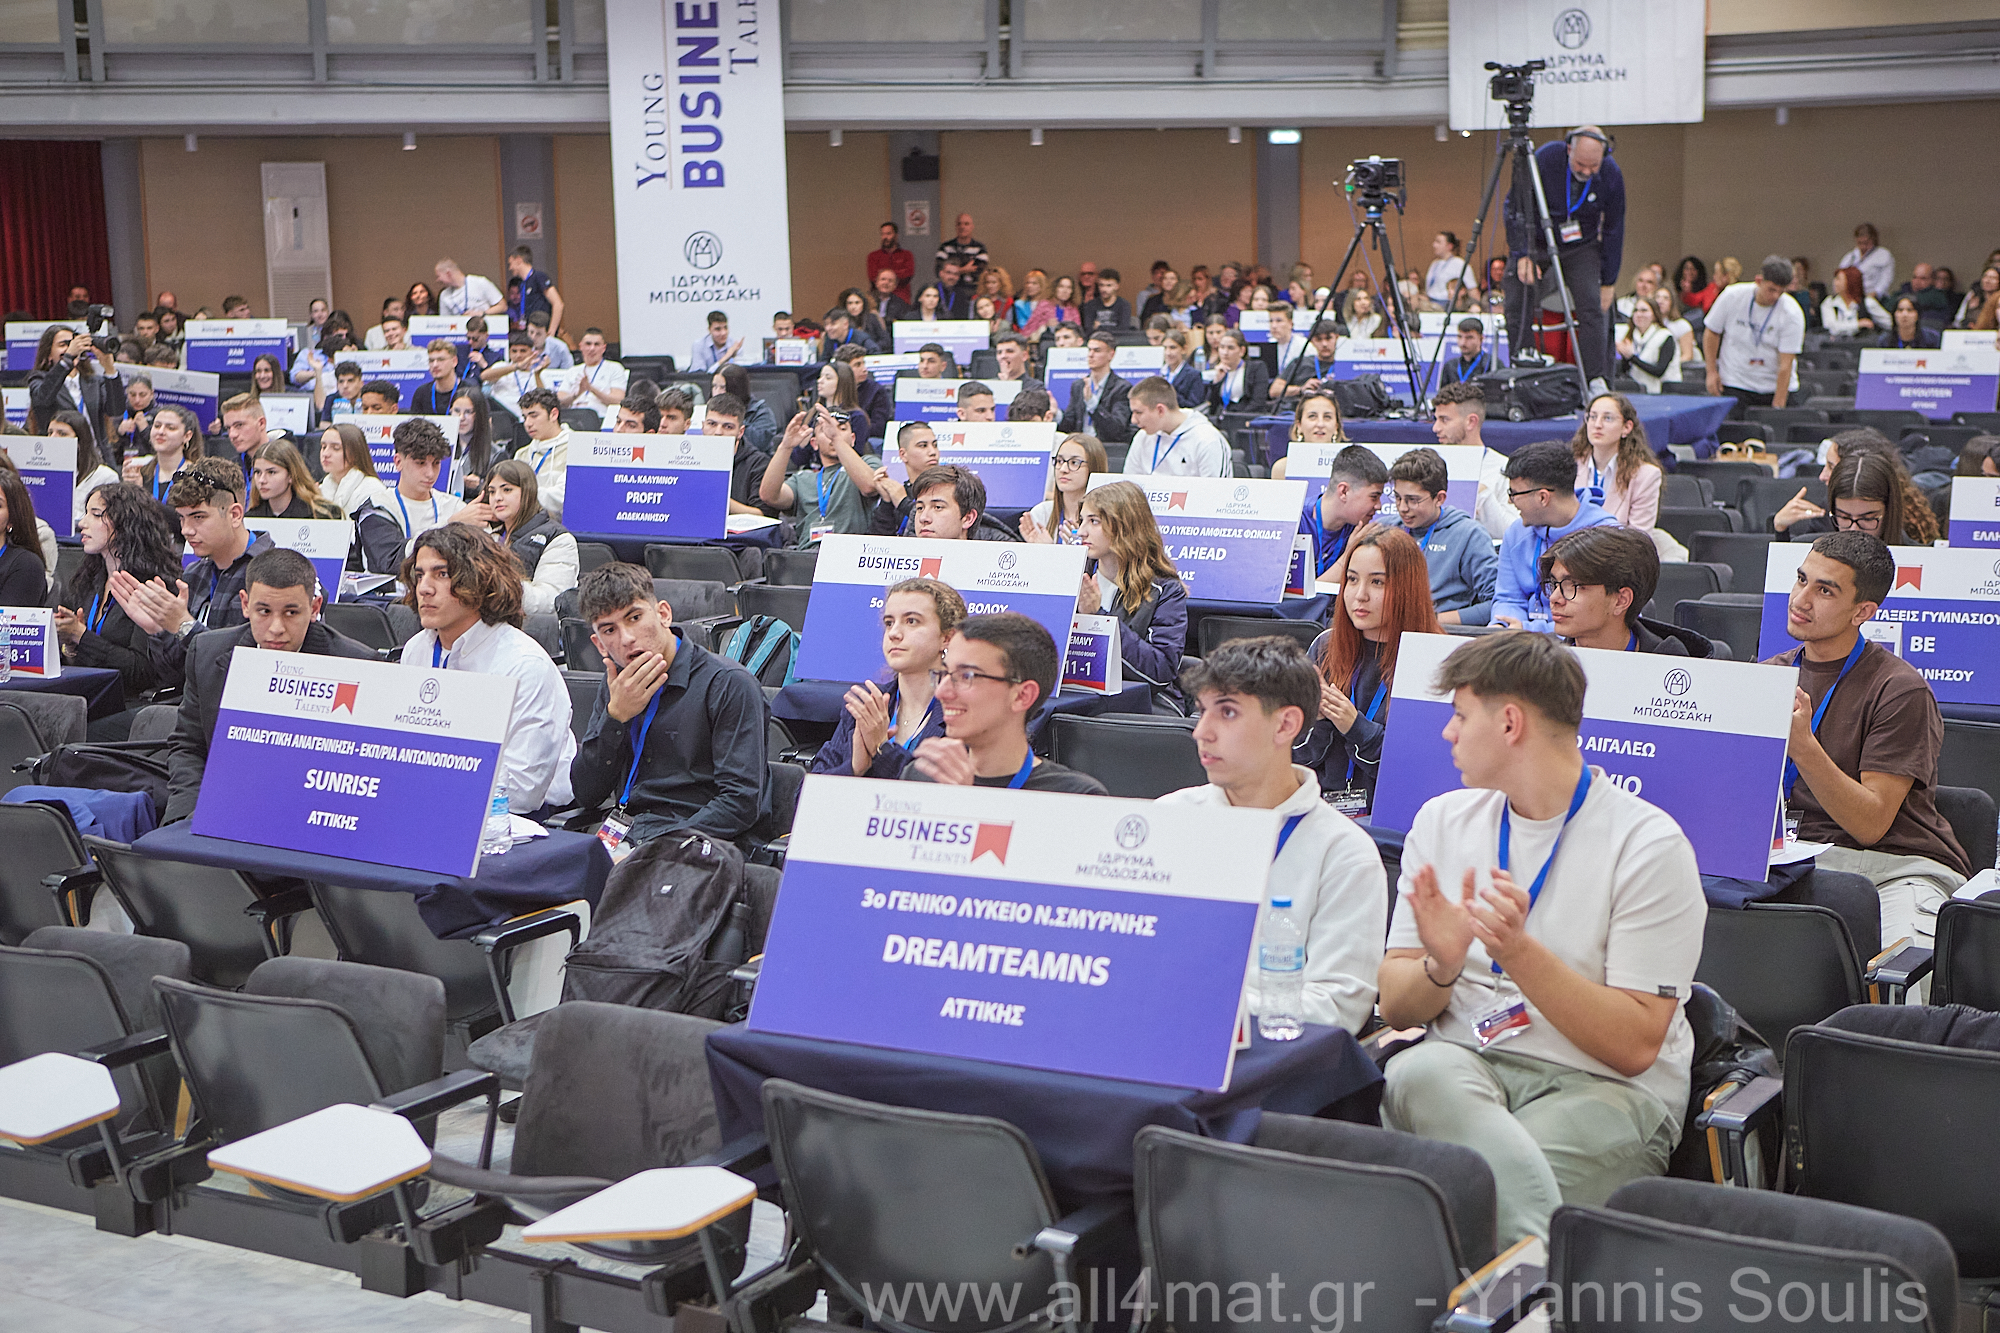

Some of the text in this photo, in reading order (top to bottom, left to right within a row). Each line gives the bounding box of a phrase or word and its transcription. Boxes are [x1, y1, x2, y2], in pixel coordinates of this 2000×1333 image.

[1532, 68, 1627, 84] ΠΟΔΟΣΑΚΗ
[636, 73, 668, 190] YOUNG
[671, 274, 738, 288] ΙΔΡΥΜΑ
[650, 288, 761, 304] ΜΠΟΔΟΣΑΚΗ
[592, 446, 632, 456] BUSINESS
[993, 457, 1041, 465] ΠΑΡΑΣΚΕΥΗΣ
[637, 475, 679, 486] ΚΑΛΥΜΝΟΥ
[626, 491, 664, 504] PROFIT
[616, 511, 670, 522] ΔΩΔΕΚΑΝΗΣΟΥ
[1169, 525, 1200, 536] ΛΥΚΕΙΟ
[1200, 527, 1243, 538] ΑΜΦΙΣΣΑΣ
[1243, 529, 1283, 540] ΦΩΚΙΔΑΣ
[863, 543, 890, 554] YOUNG
[858, 556, 920, 571] BUSINESS
[977, 578, 1030, 588] ΜΠΟΔΟΣΑΚΗ
[989, 571, 1020, 580] ΙΔΡΥΜΑ
[967, 602, 1009, 614] ΒΟΛΟΥ
[273, 660, 304, 675] YOUNG
[268, 677, 335, 700] BUSINESS
[294, 698, 330, 714] TALENTS
[408, 705, 442, 717] ΙΔΡΥΜΑ
[1650, 697, 1698, 710] ΙΔΡΥΜΑ
[394, 714, 451, 729] ΜΠΟΔΟΣΑΚΗ
[1633, 706, 1712, 723] ΜΠΟΔΟΣΑΚΗ
[227, 725, 292, 747] ΕΚΠΑΙΔΕΥΤΙΚΗ
[292, 733, 355, 755] ΑΝΑΓΕΝΝΗΣΗ
[359, 742, 398, 762] ΕΚΠ/ΡΙΑ
[399, 746, 482, 772] ΑΝΤΩΝΟΠΟΥΛΟΥ
[1585, 735, 1656, 758] ΑΙΓΑΛΕΩ
[304, 768, 380, 799] SUNRISE
[873, 793, 922, 813] YOUNG
[307, 810, 359, 832] ΑΤΤΙΚΗΣ
[866, 817, 973, 845] BUSINESS
[910, 843, 968, 865] TALENTS
[1097, 852, 1154, 868] ΙΔΡΥΜΑ
[1075, 864, 1172, 884] ΜΠΟΔΟΣΑΚΗ
[861, 888, 1158, 937] 3ο ΓΕΝΙΚΟ ΛΥΚΕΙΟ Ν.ΣΜΥΡΝΗΣ
[882, 934, 1111, 987] DREAMTEAMNS
[940, 997, 1026, 1027] ΑΤΤΙΚΗΣ
